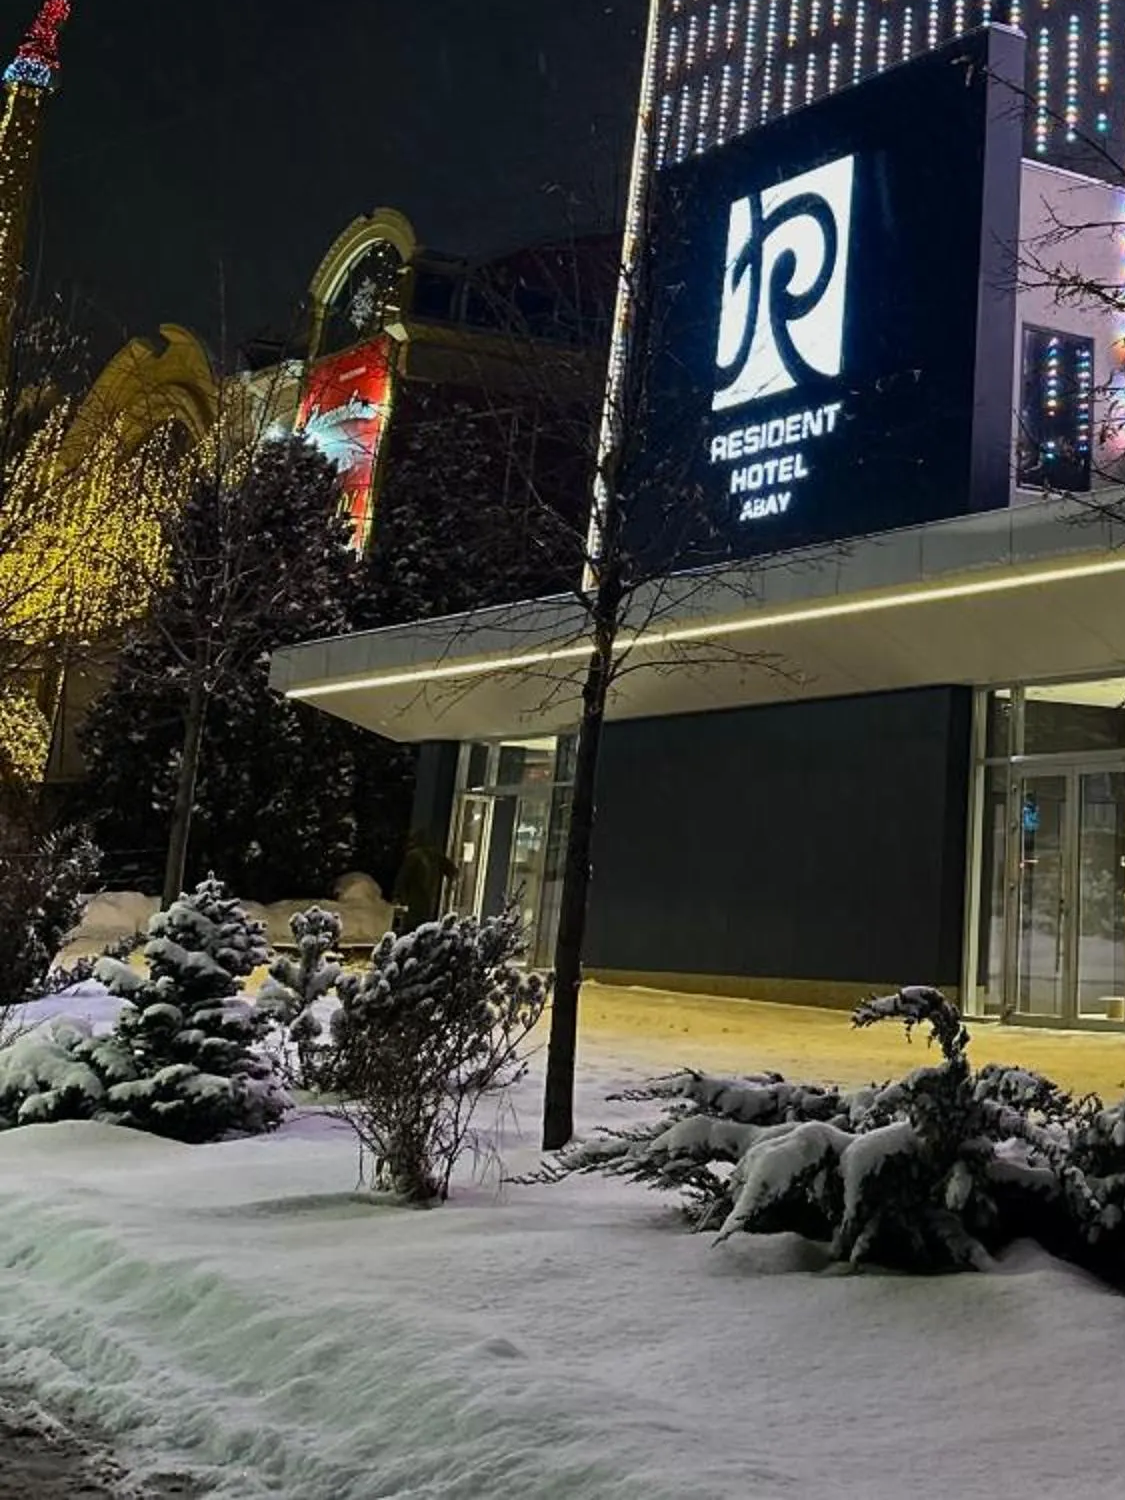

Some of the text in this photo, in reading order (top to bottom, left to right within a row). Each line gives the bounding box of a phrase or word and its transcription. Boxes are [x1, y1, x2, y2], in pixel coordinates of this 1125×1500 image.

[710, 402, 842, 463] RESIDENT
[730, 453, 808, 494] HOTEL
[738, 491, 792, 521] ABAY
